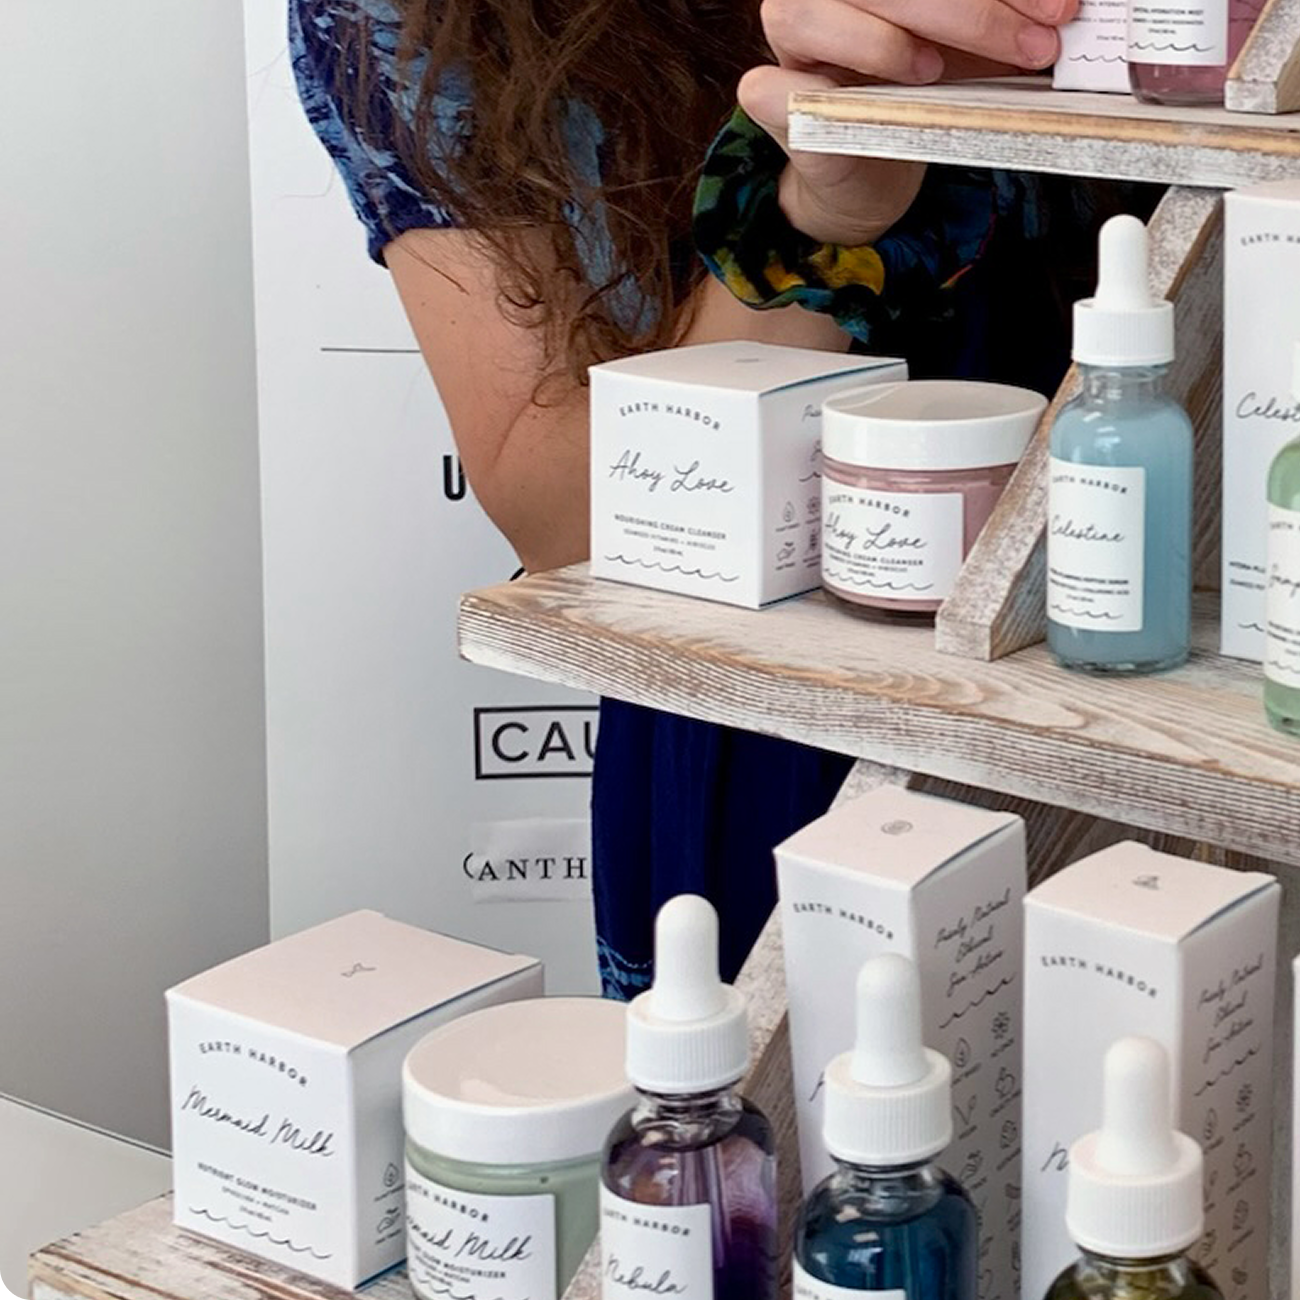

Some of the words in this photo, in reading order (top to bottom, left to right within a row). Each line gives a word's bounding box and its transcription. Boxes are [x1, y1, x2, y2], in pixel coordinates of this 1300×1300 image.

[1240, 233, 1280, 247] EARTH
[620, 401, 660, 418] EARTH
[665, 403, 721, 432] HARBOR
[608, 448, 663, 488] Ahoy
[668, 460, 736, 495] Love
[859, 498, 910, 518] HARBOR
[660, 521, 685, 533] CREAM
[687, 527, 726, 540] CLEANSER
[863, 522, 928, 550] Love
[1050, 513, 1126, 543] Celestine
[793, 901, 834, 917] EARTH
[838, 904, 896, 942] HARBOR
[1040, 954, 1088, 970] EARTH
[1095, 964, 1158, 1000] HARBOR
[198, 1040, 242, 1057] EARTH
[248, 1048, 309, 1089] HARBOR
[181, 1082, 269, 1139] Mermaid
[270, 1117, 336, 1159] Milk
[433, 1194, 489, 1223] HARBOR
[633, 1217, 691, 1237] HARBOR
[454, 1231, 533, 1263] Milk
[604, 1252, 689, 1295] Nebula
